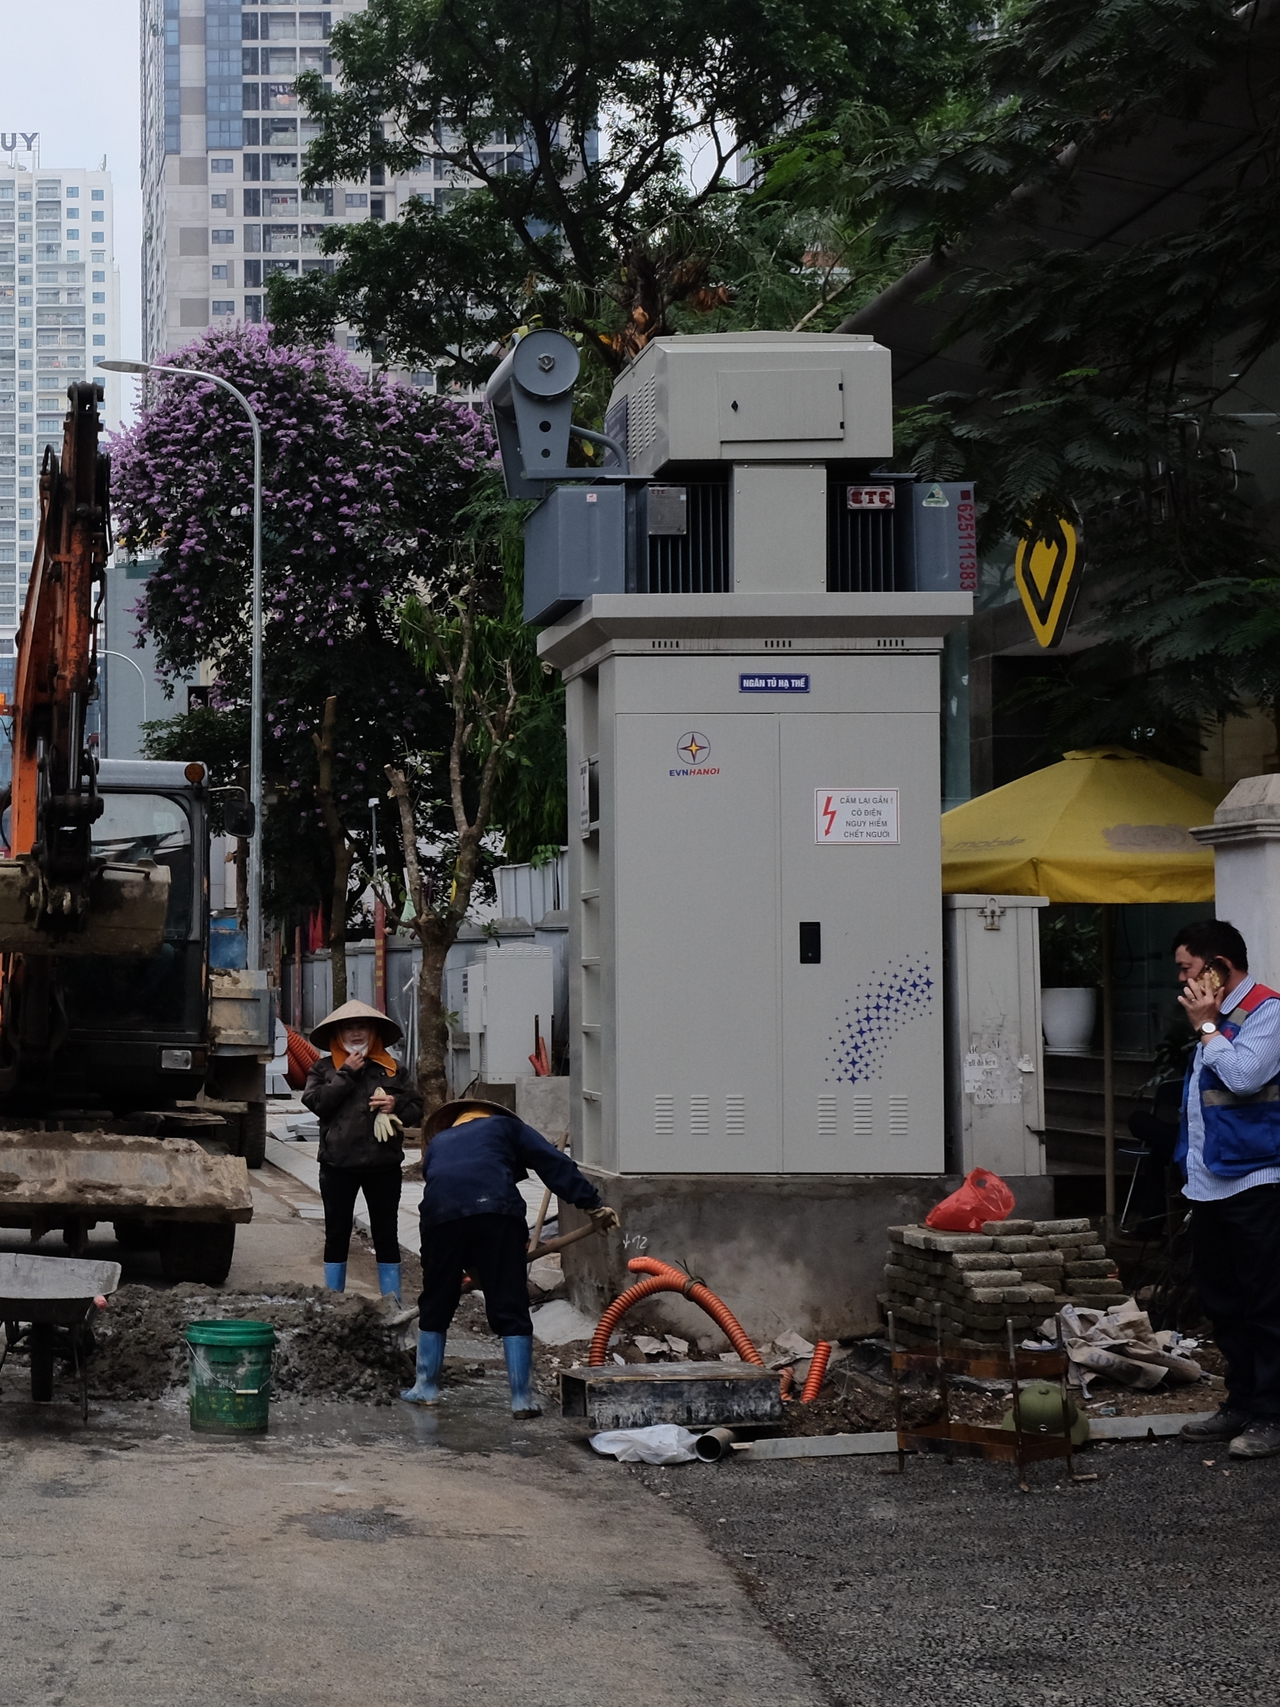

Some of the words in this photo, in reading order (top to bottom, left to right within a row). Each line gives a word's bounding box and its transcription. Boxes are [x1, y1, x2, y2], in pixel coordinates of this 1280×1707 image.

[956, 503, 978, 590] 625111383
[742, 678, 766, 688] NGĂN
[766, 676, 777, 688] TỦ
[778, 679, 790, 690] HẠ
[791, 676, 806, 688] THẾ
[669, 768, 720, 777] EVNHANOI
[840, 794, 857, 804] CẤM
[851, 808, 862, 816] CÓ
[864, 808, 882, 818] ĐIỆN
[843, 829, 864, 838] CHẾT
